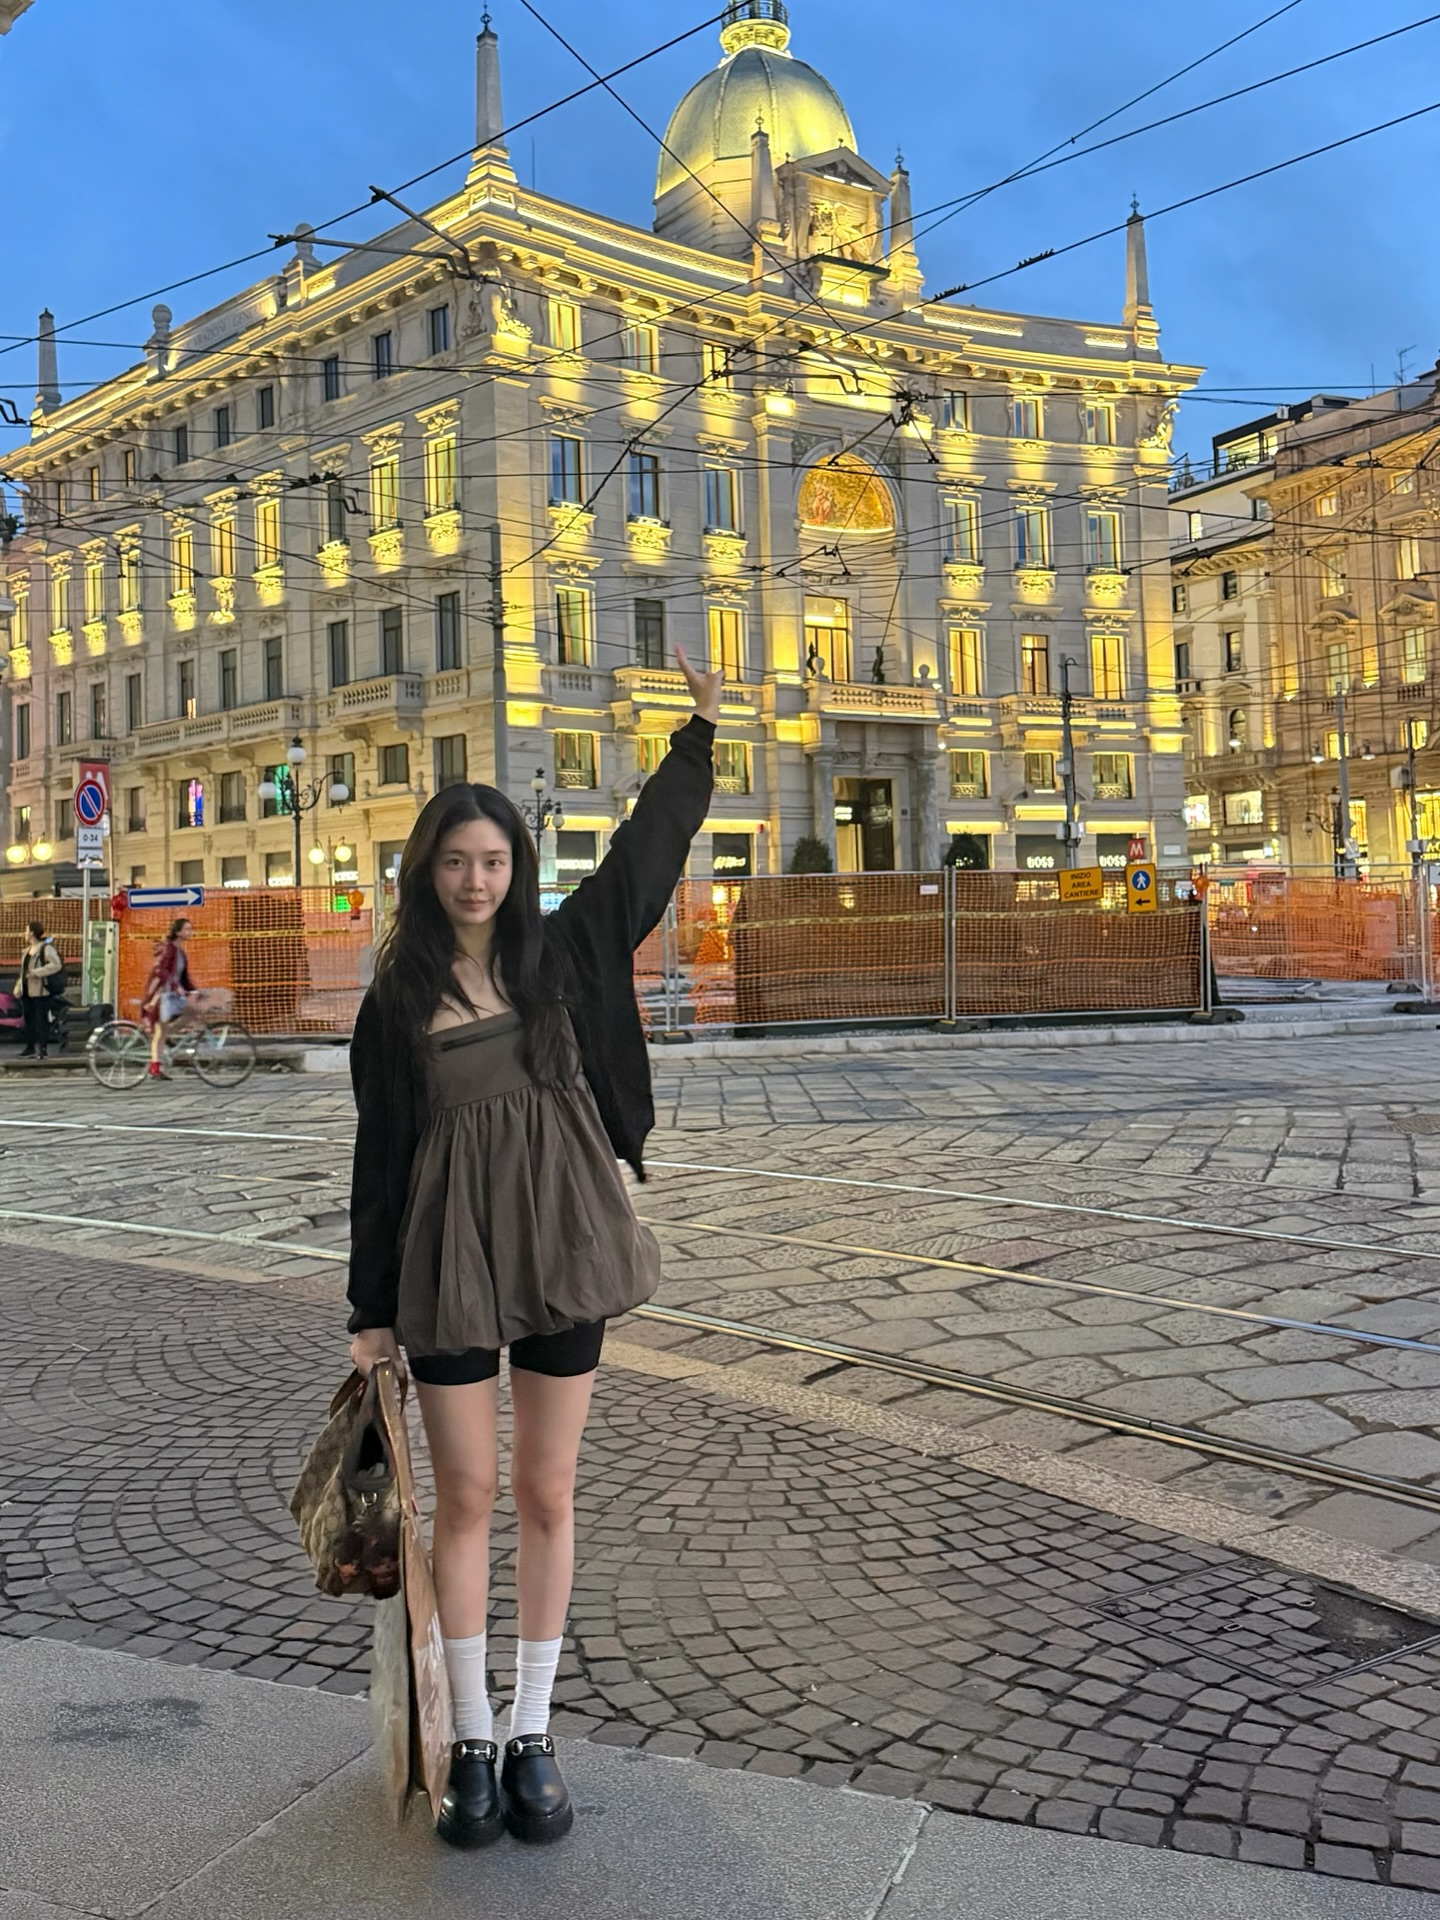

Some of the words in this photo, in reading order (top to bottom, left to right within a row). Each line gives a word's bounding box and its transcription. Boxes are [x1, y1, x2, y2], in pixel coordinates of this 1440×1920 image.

[1130, 843, 1143, 856] M
[1027, 856, 1054, 868] BOSS
[1099, 855, 1127, 867] BOSS
[1071, 872, 1091, 880] INIZIO
[1072, 881, 1091, 889] AREA
[1064, 889, 1099, 899] CANTIERE
